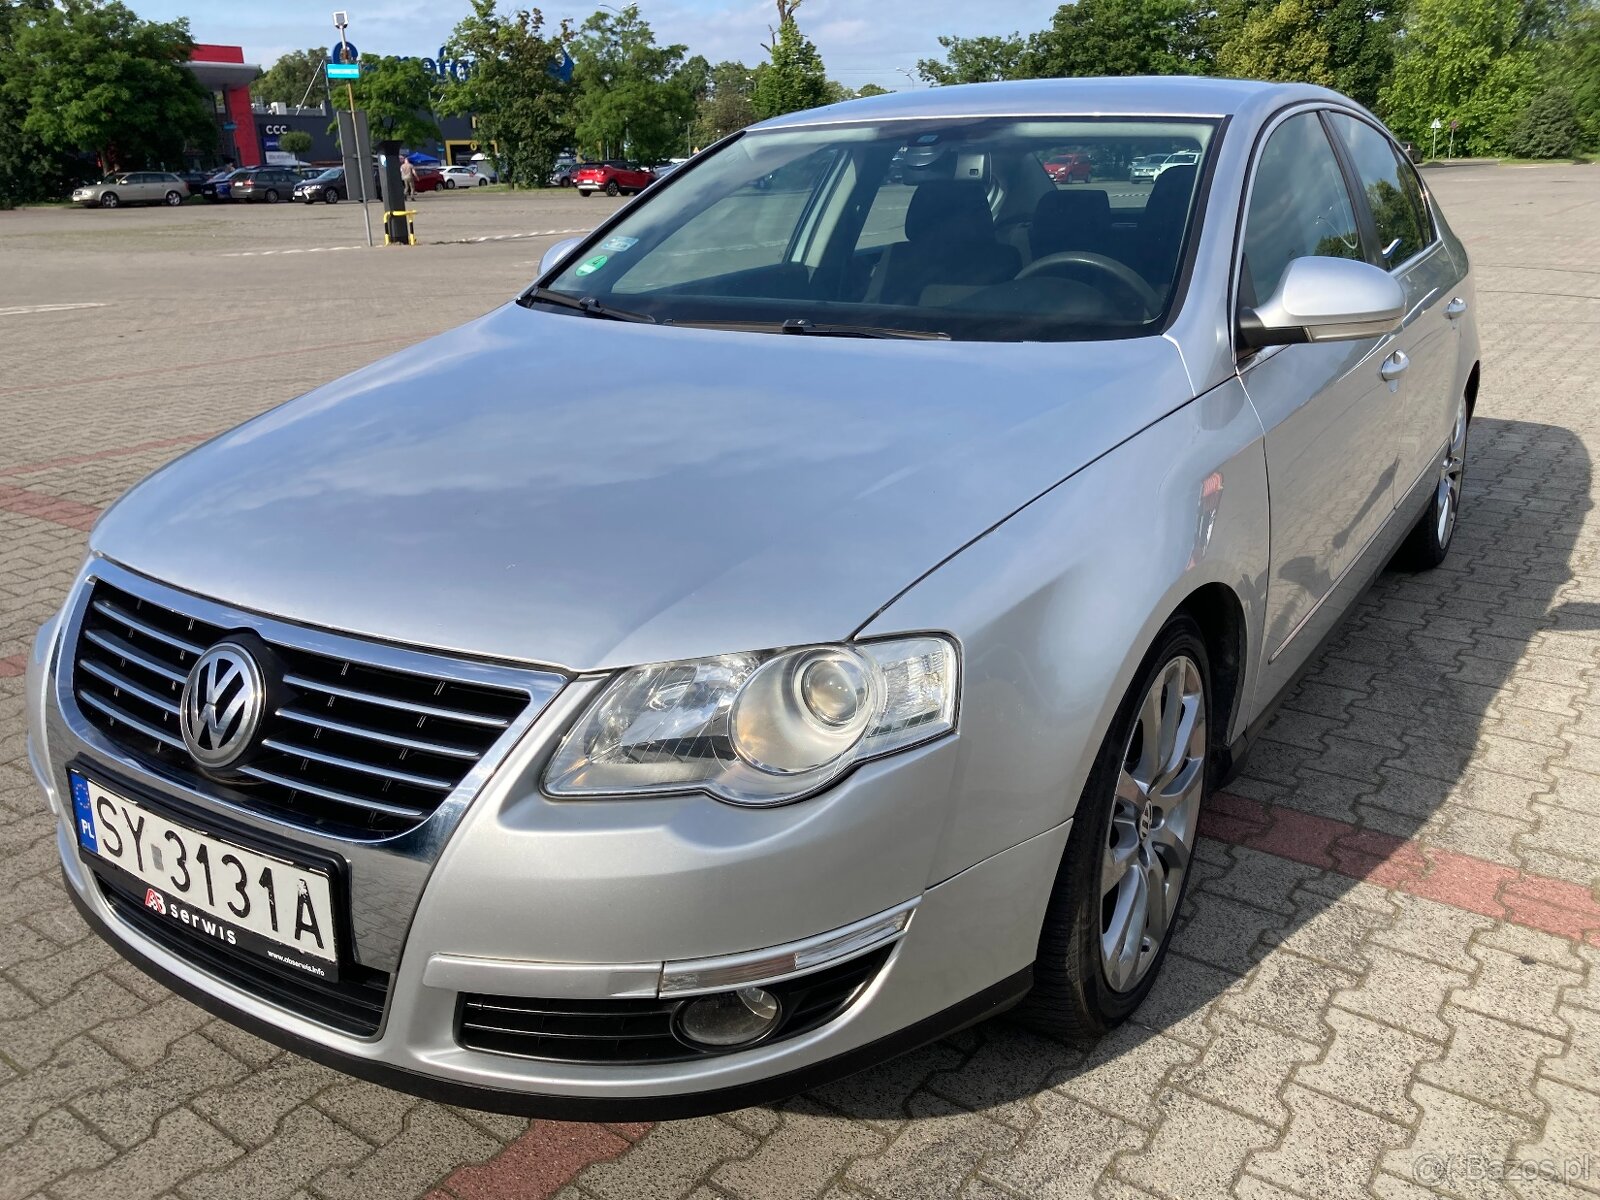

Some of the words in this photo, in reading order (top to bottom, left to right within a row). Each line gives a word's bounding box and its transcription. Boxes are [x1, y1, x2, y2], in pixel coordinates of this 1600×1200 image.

[265, 125, 288, 135] CCC
[81, 819, 95, 840] PL
[97, 796, 145, 873] SY
[165, 829, 325, 949] 3131A
[170, 902, 237, 945] serwis
